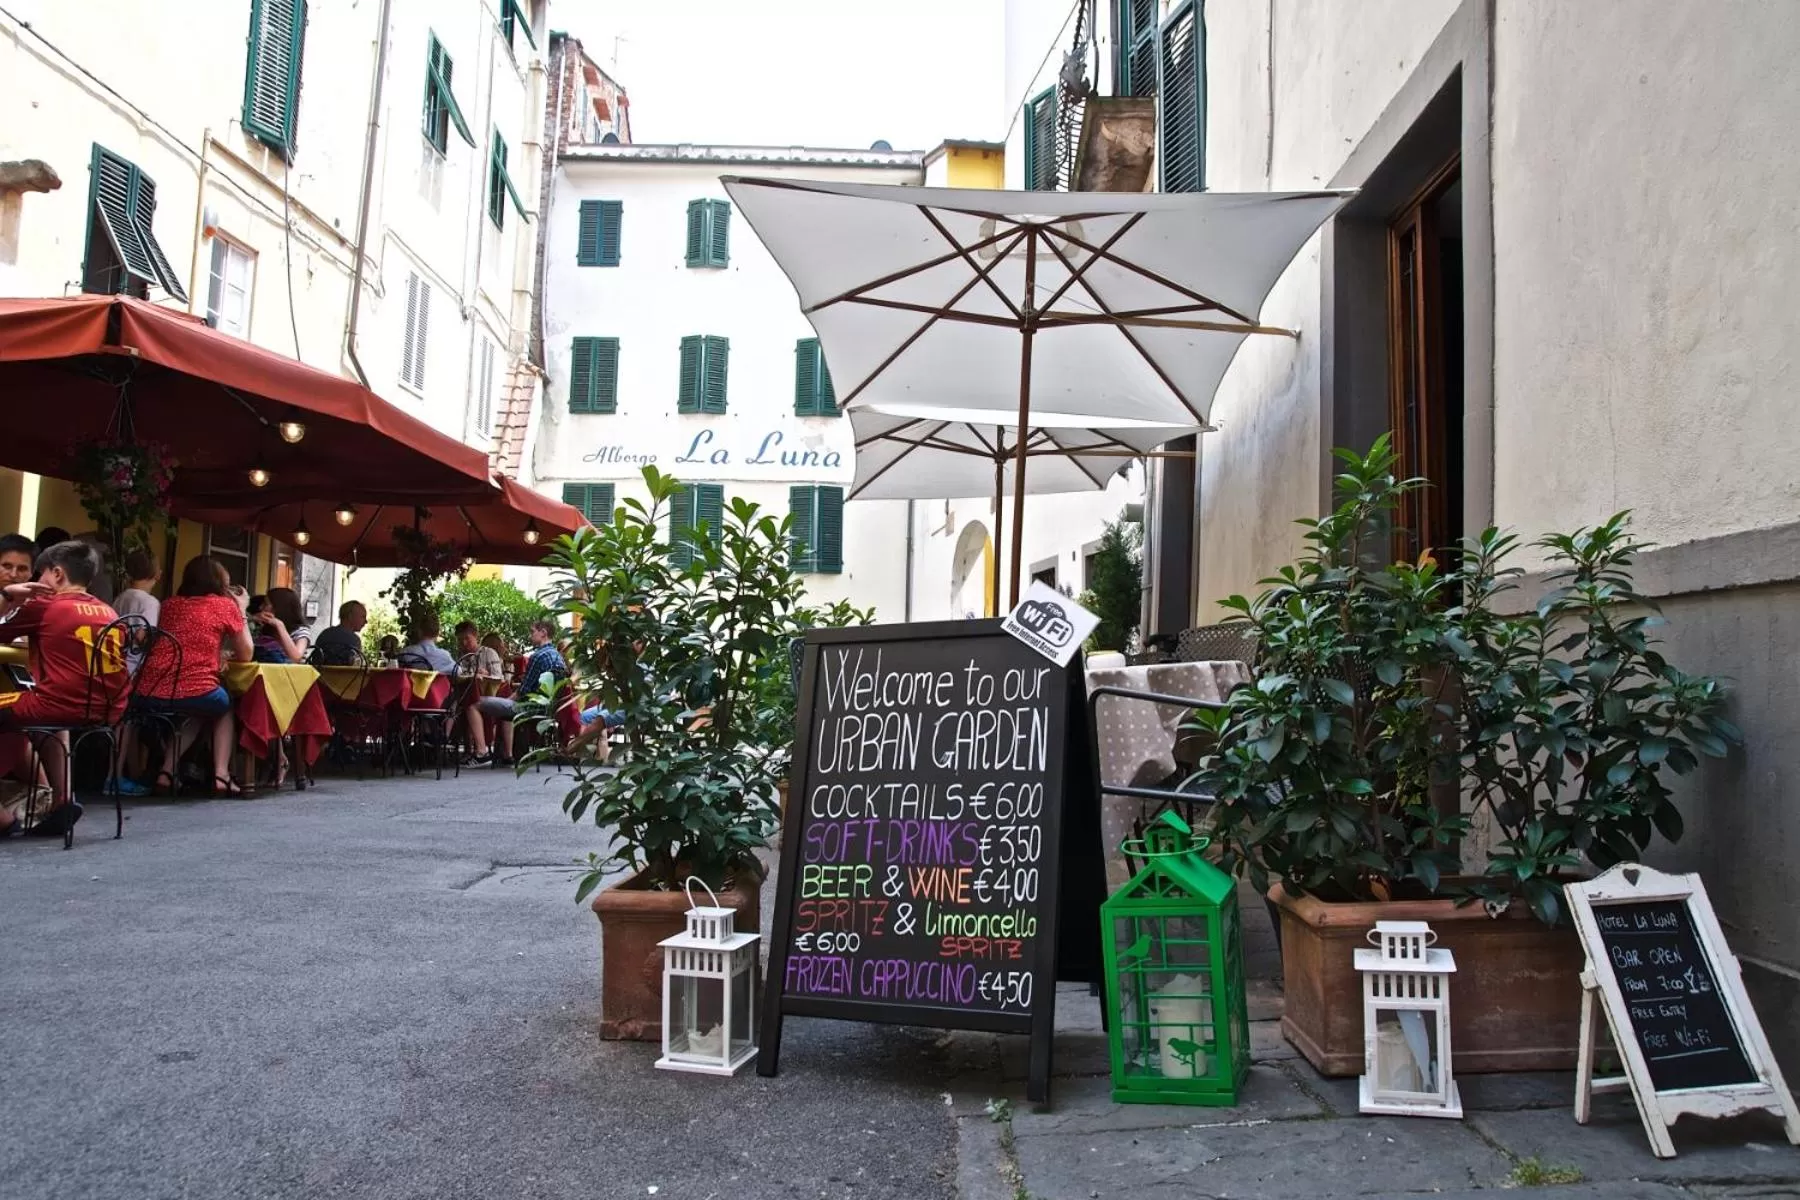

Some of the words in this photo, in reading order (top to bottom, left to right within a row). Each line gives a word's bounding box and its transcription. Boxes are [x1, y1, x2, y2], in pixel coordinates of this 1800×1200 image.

[583, 446, 657, 470] Albergo
[675, 429, 731, 465] La
[745, 430, 841, 468] Luna
[75, 625, 122, 676] 10
[823, 648, 954, 712] Welcome
[964, 658, 994, 707] to
[1003, 666, 1051, 702] our
[817, 711, 923, 773] URBAN
[932, 707, 1049, 773] GARDEN
[810, 783, 964, 820] COCKTAILS
[804, 819, 979, 865] SOFT-DRINKS
[801, 864, 873, 899] BEER
[882, 864, 905, 898] &
[908, 867, 973, 904] WINE
[796, 899, 890, 936] SPRITZ
[893, 902, 916, 935] &
[1595, 912, 1628, 931] HOTEL
[1634, 912, 1647, 929] LA
[1651, 911, 1678, 928] LUNA
[939, 936, 1024, 959] SPRITZ
[1612, 945, 1644, 969] BAR
[1650, 943, 1684, 967] OPEN
[785, 955, 853, 995] FROZEN
[860, 958, 976, 1003] CAPPUCCINO
[1631, 1006, 1656, 1020] FREE
[1643, 1029, 1669, 1049] FREE
